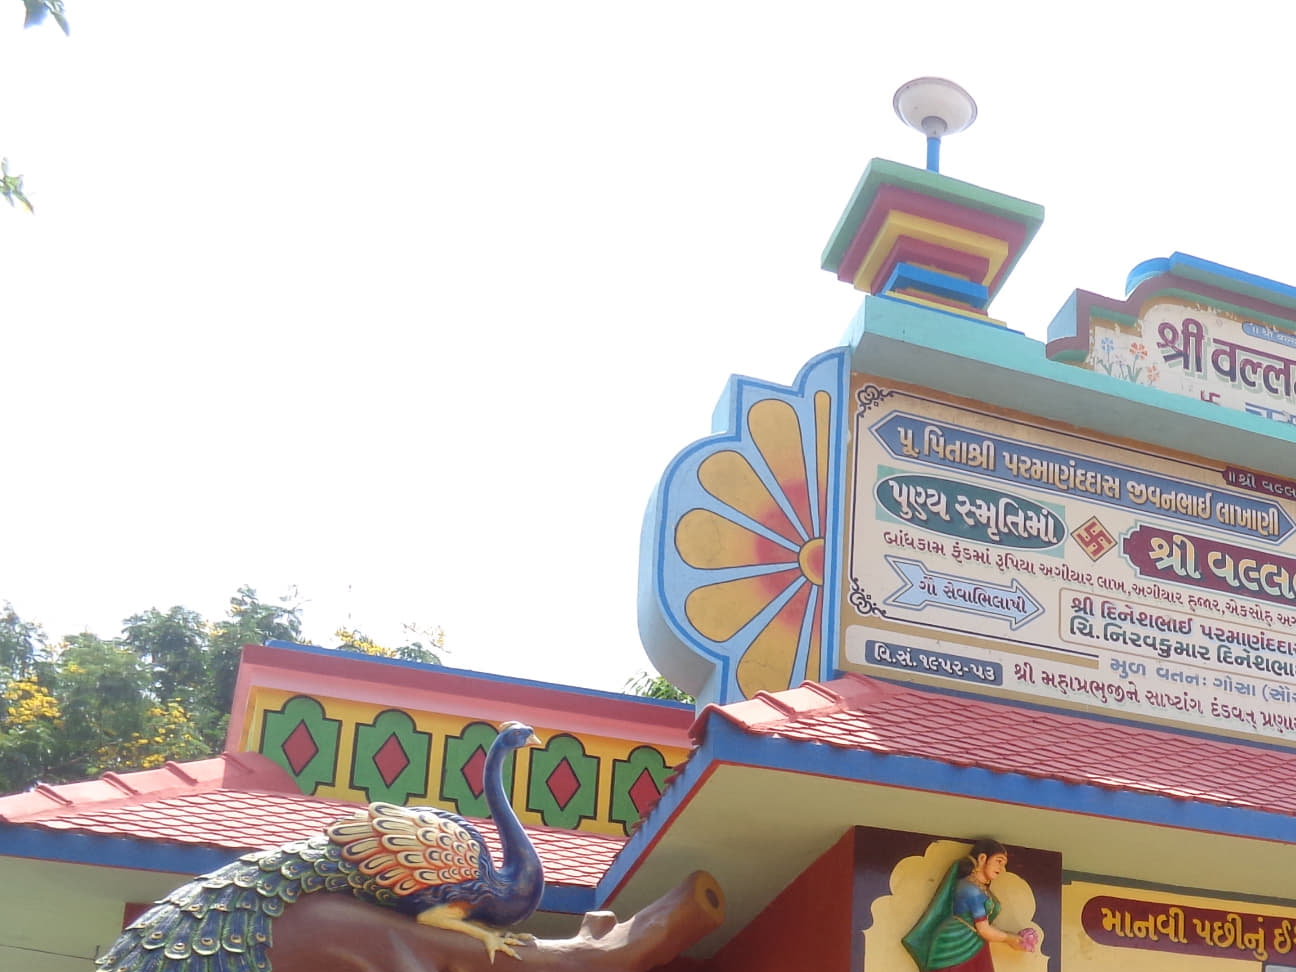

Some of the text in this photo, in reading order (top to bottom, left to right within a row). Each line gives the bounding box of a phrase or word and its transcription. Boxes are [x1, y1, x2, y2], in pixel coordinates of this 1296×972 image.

[1157, 318, 1204, 373] श्री
[924, 425, 996, 471] પિતાશ્રી
[1003, 451, 1121, 500] પરમાણંદદાસ
[1127, 481, 1211, 518] જીવનભાઈ
[1215, 501, 1280, 536] લાખાણી
[888, 480, 1058, 544] પુણ્ય સ્મૃતિમાં
[884, 531, 945, 556] બાંધકામ
[1039, 563, 1092, 585] અગીયાર
[1149, 535, 1203, 580] શ્રી
[943, 581, 1027, 614] સેવાભિલાષી
[1071, 596, 1094, 617] શ્રી
[1101, 600, 1193, 635] દિનેશભાઈ
[1014, 662, 1036, 684] શ્રી
[1041, 670, 1140, 704] મહાપ્રભુજીને
[1145, 689, 1204, 714] સાષ્ટાંગ
[1110, 658, 1146, 679] મુળ
[1213, 675, 1256, 697] ગોસા
[1100, 906, 1188, 945] માનવી
[1193, 913, 1268, 962] પછીનું
